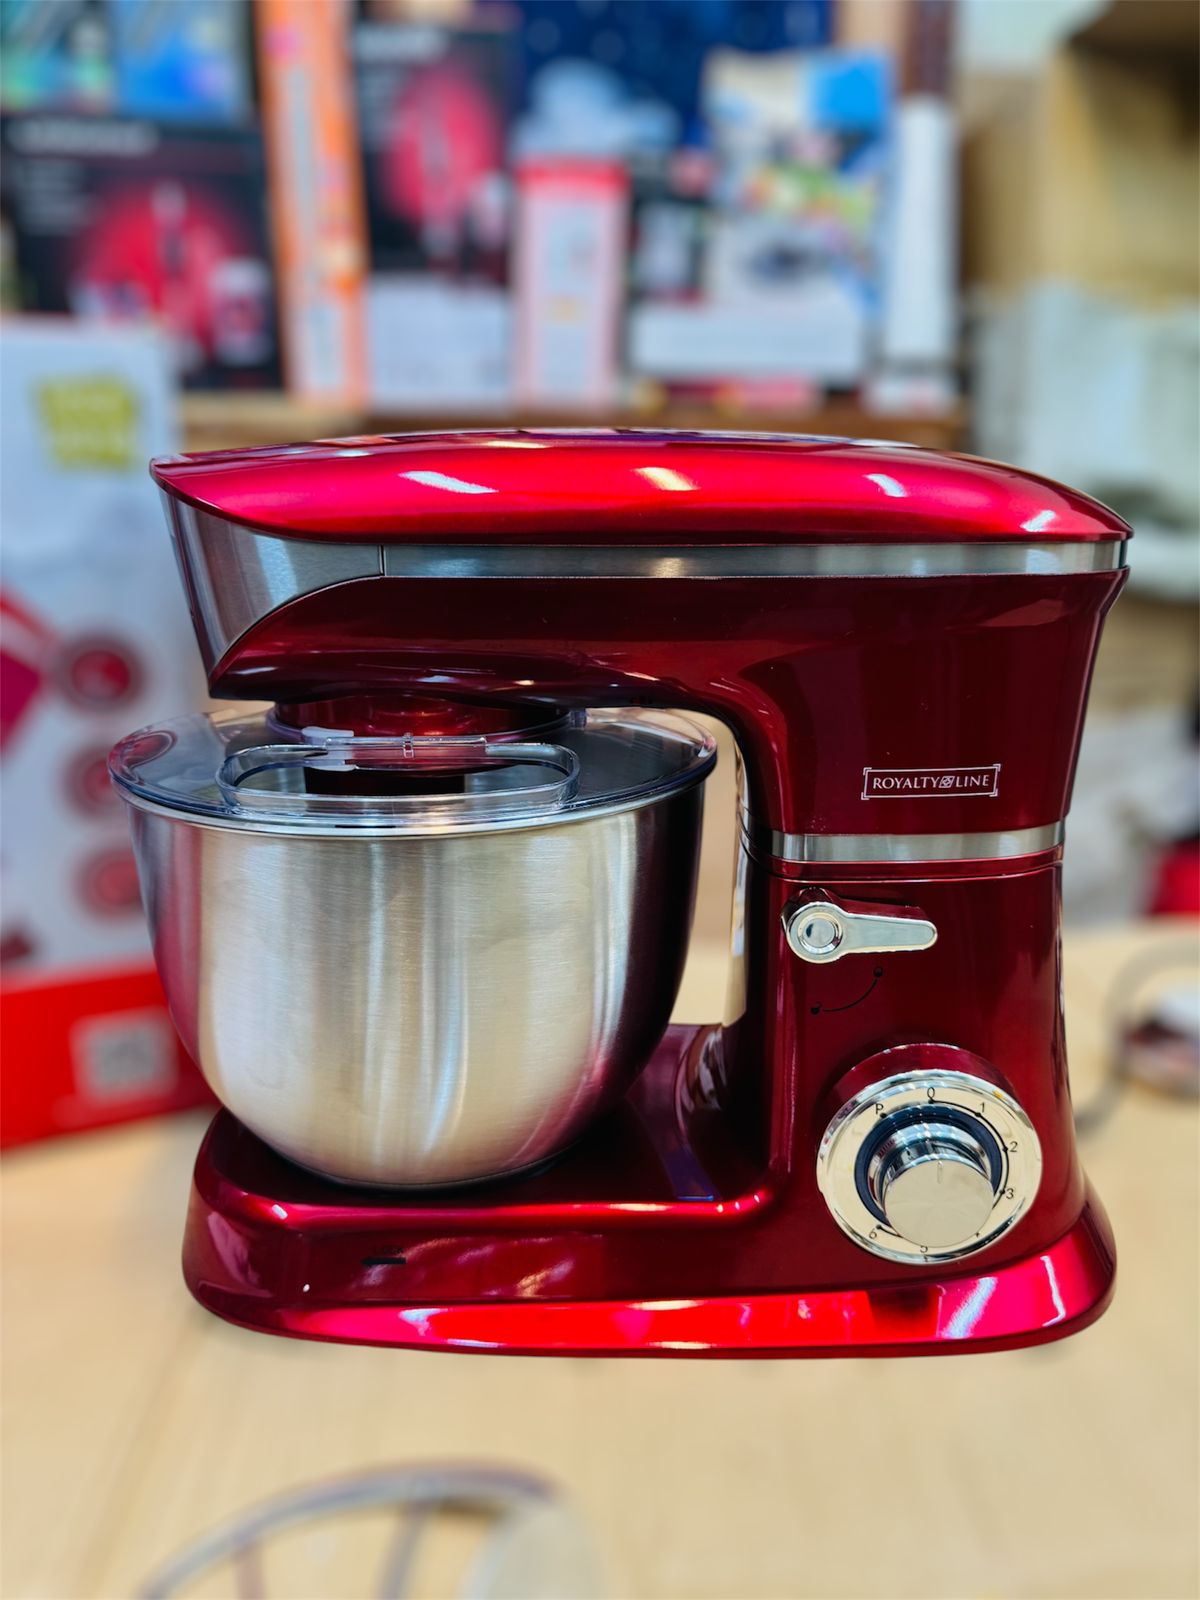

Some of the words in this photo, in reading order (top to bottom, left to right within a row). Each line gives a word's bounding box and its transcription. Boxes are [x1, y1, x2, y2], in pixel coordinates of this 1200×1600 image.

[873, 777, 940, 790] ROYALTY
[955, 775, 990, 787] LINE
[875, 1103, 884, 1115] P
[979, 1102, 986, 1113] 1
[1009, 1140, 1018, 1153] 2
[1005, 1187, 1015, 1200] 3
[868, 1227, 878, 1240] 6
